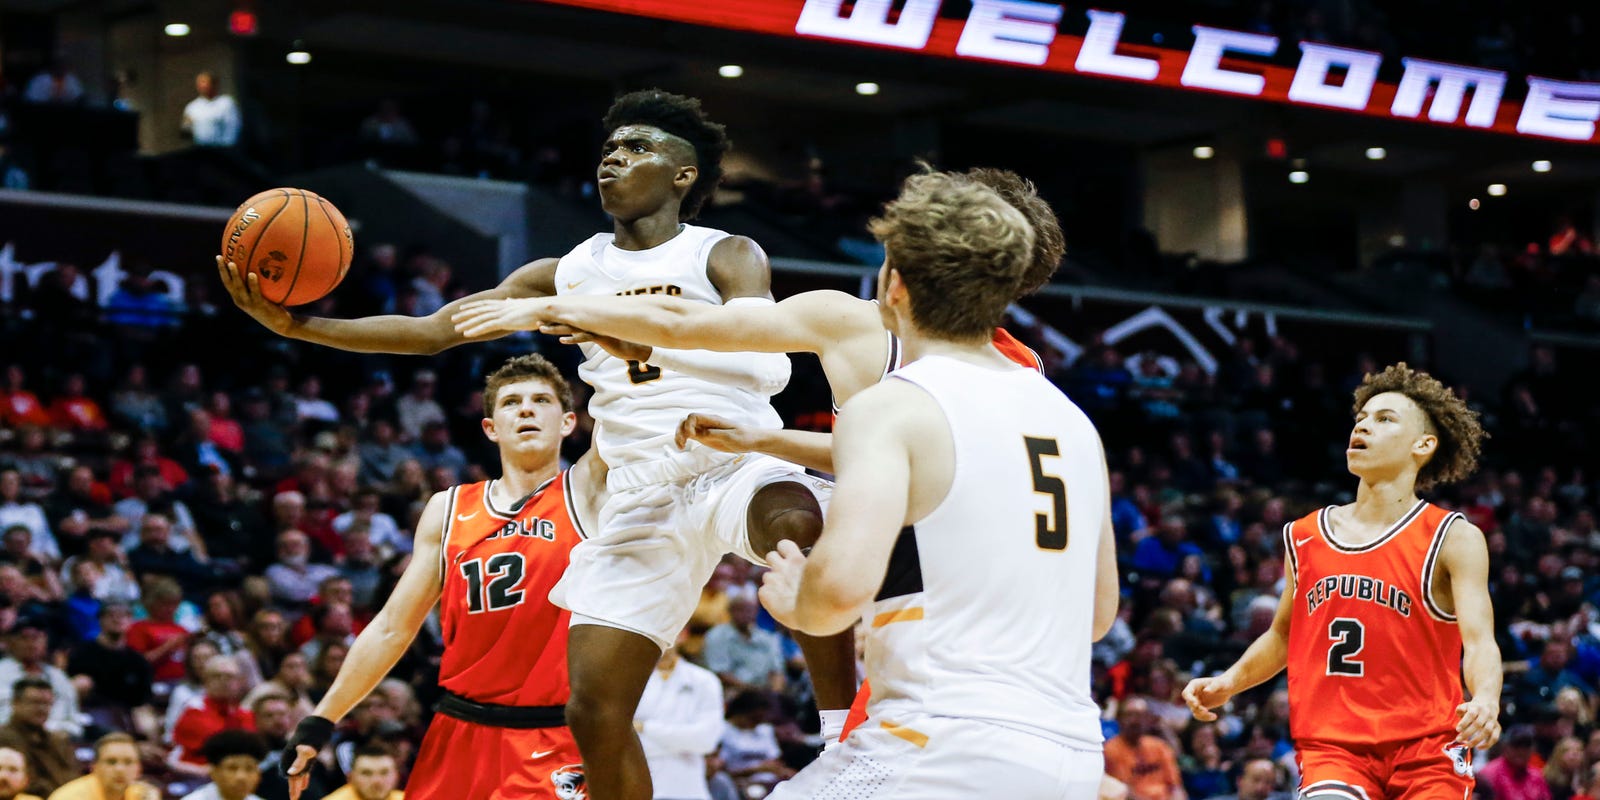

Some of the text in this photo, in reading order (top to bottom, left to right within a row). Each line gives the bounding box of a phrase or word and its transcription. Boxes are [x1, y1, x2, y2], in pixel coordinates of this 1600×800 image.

[795, 0, 1600, 141] WELCOME
[1021, 433, 1069, 553] 5
[460, 551, 526, 614] 12
[1306, 574, 1412, 617] REPUBLIC
[1326, 617, 1364, 677] 2
